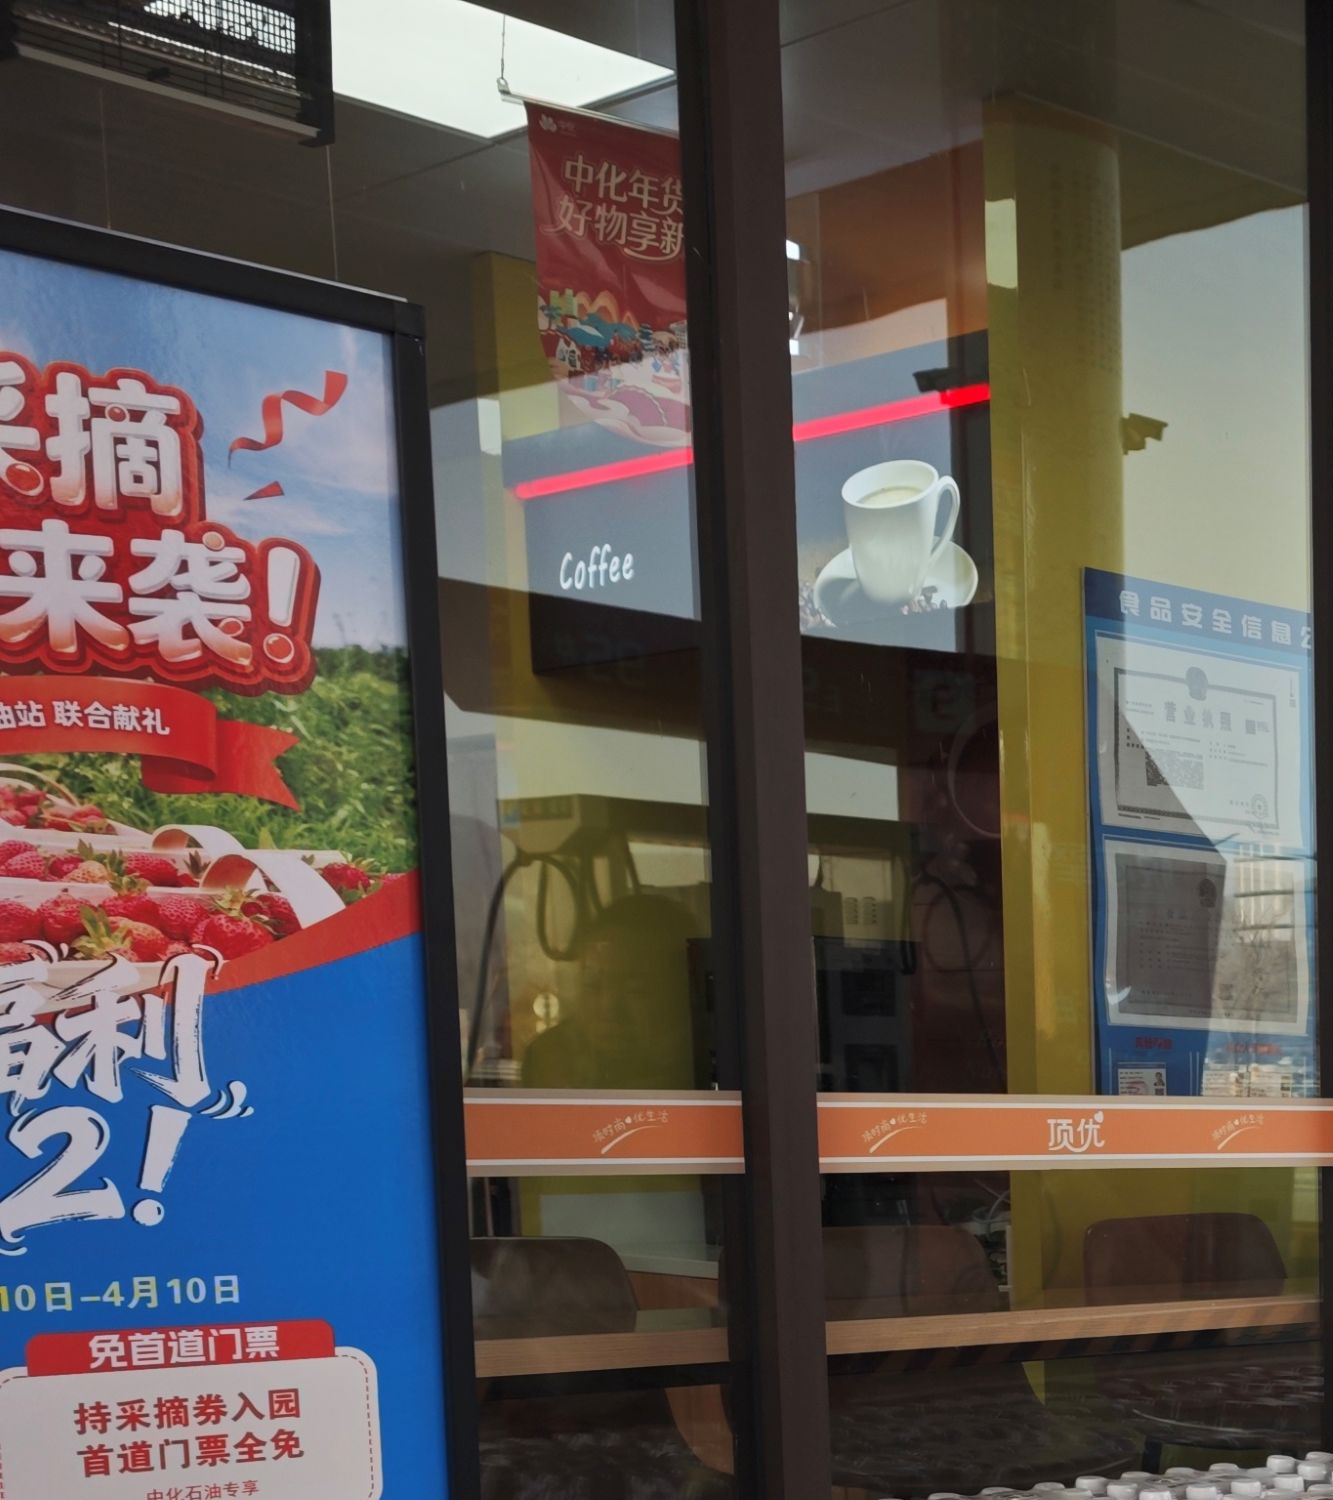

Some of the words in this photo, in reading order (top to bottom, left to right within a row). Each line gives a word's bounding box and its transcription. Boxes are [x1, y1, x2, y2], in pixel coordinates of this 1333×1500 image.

[559, 543, 634, 592] Coffee
[0, 520, 299, 665] 来袭!
[52, 700, 170, 735] 联合献礼
[1047, 1111, 1105, 1151] 顶优
[89, 1325, 280, 1369] 免首道门票
[74, 1388, 302, 1435] 持采摘券入园
[77, 1428, 304, 1478] 首道门票全免
